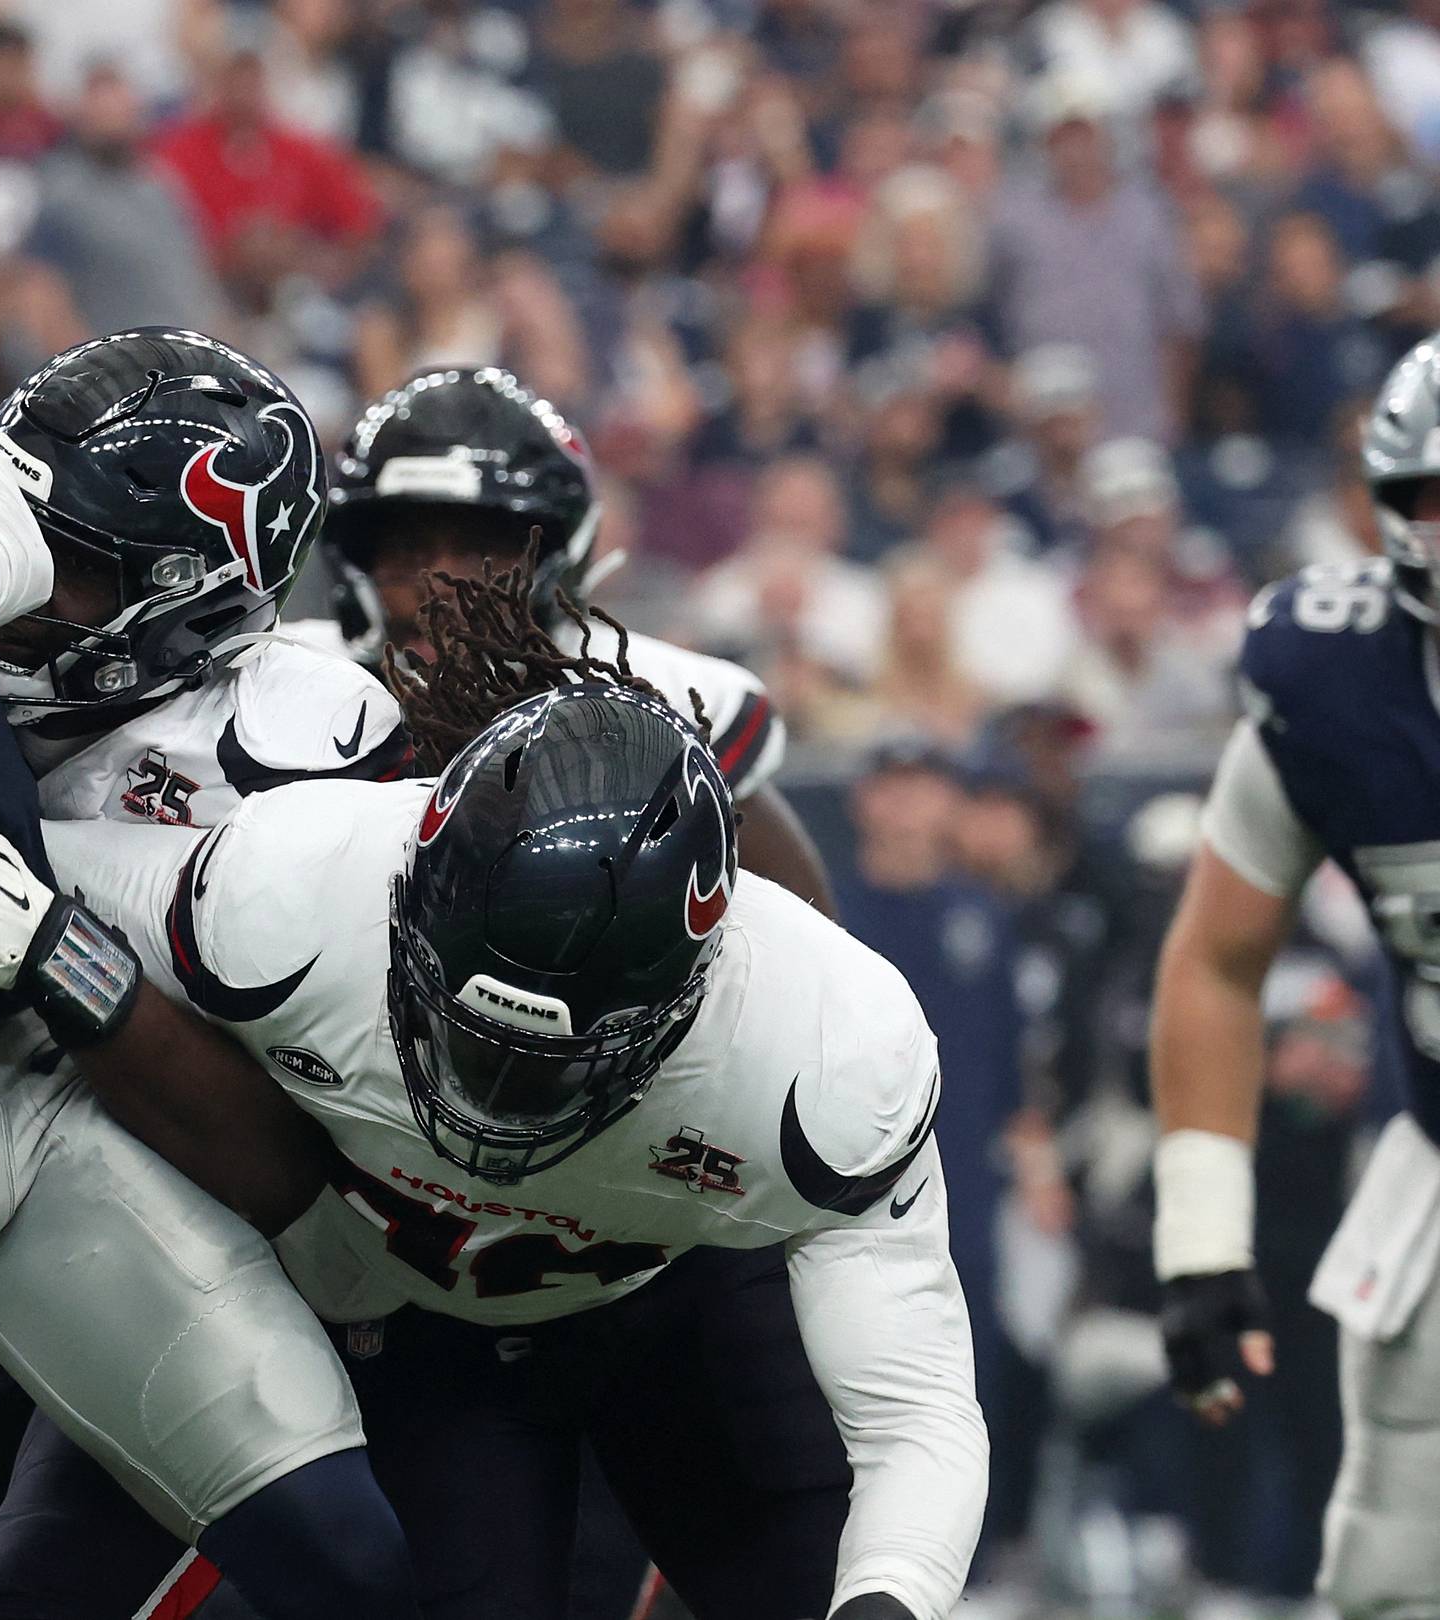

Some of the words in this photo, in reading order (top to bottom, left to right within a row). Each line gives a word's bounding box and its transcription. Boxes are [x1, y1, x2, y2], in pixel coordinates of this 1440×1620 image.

[122, 758, 201, 825] 25
[475, 985, 559, 1020] TEXANS
[275, 1051, 303, 1070] RCM
[307, 1064, 334, 1083] JSM
[656, 1135, 747, 1189] 25
[390, 1166, 597, 1242] HOUSTON
